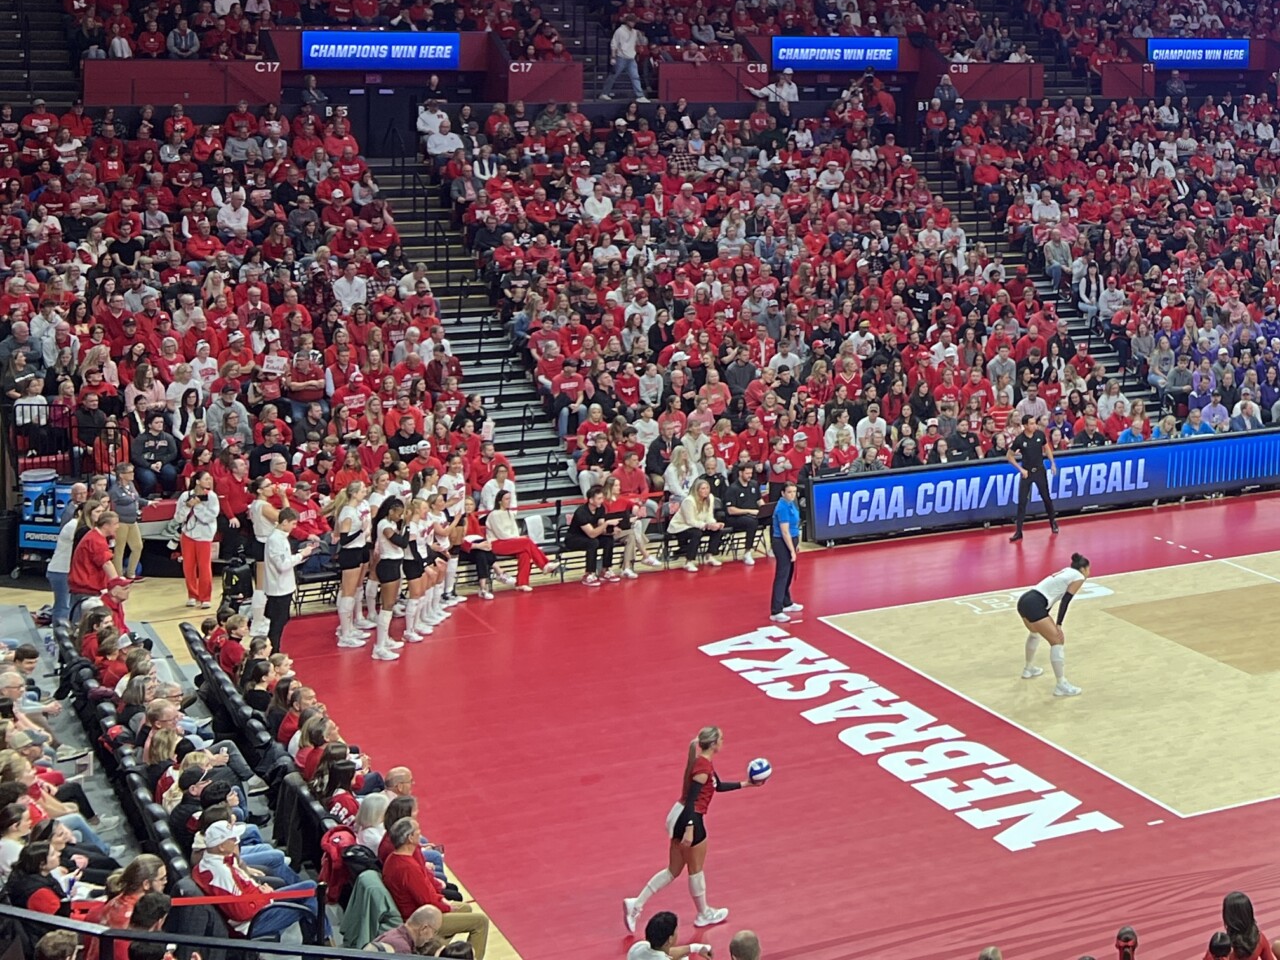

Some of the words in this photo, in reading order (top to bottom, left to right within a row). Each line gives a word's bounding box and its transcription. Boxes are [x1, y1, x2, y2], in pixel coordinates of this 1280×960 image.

[310, 44, 388, 59] CHAMPIONS
[391, 45, 417, 59] WIN
[418, 45, 452, 59] HERE
[778, 47, 842, 61] CHAMPIONS
[843, 48, 865, 61] WIN
[865, 48, 893, 61] HERE
[1153, 49, 1203, 60] CHAMPIONS
[1204, 49, 1222, 60] WIN
[1222, 49, 1245, 61] HERE
[254, 61, 280, 73] C17
[509, 62, 533, 73] C17
[747, 63, 768, 73] C18
[950, 64, 969, 74] C18
[25, 532, 60, 541] POWERAD
[697, 626, 1124, 852] NEBRASKA
